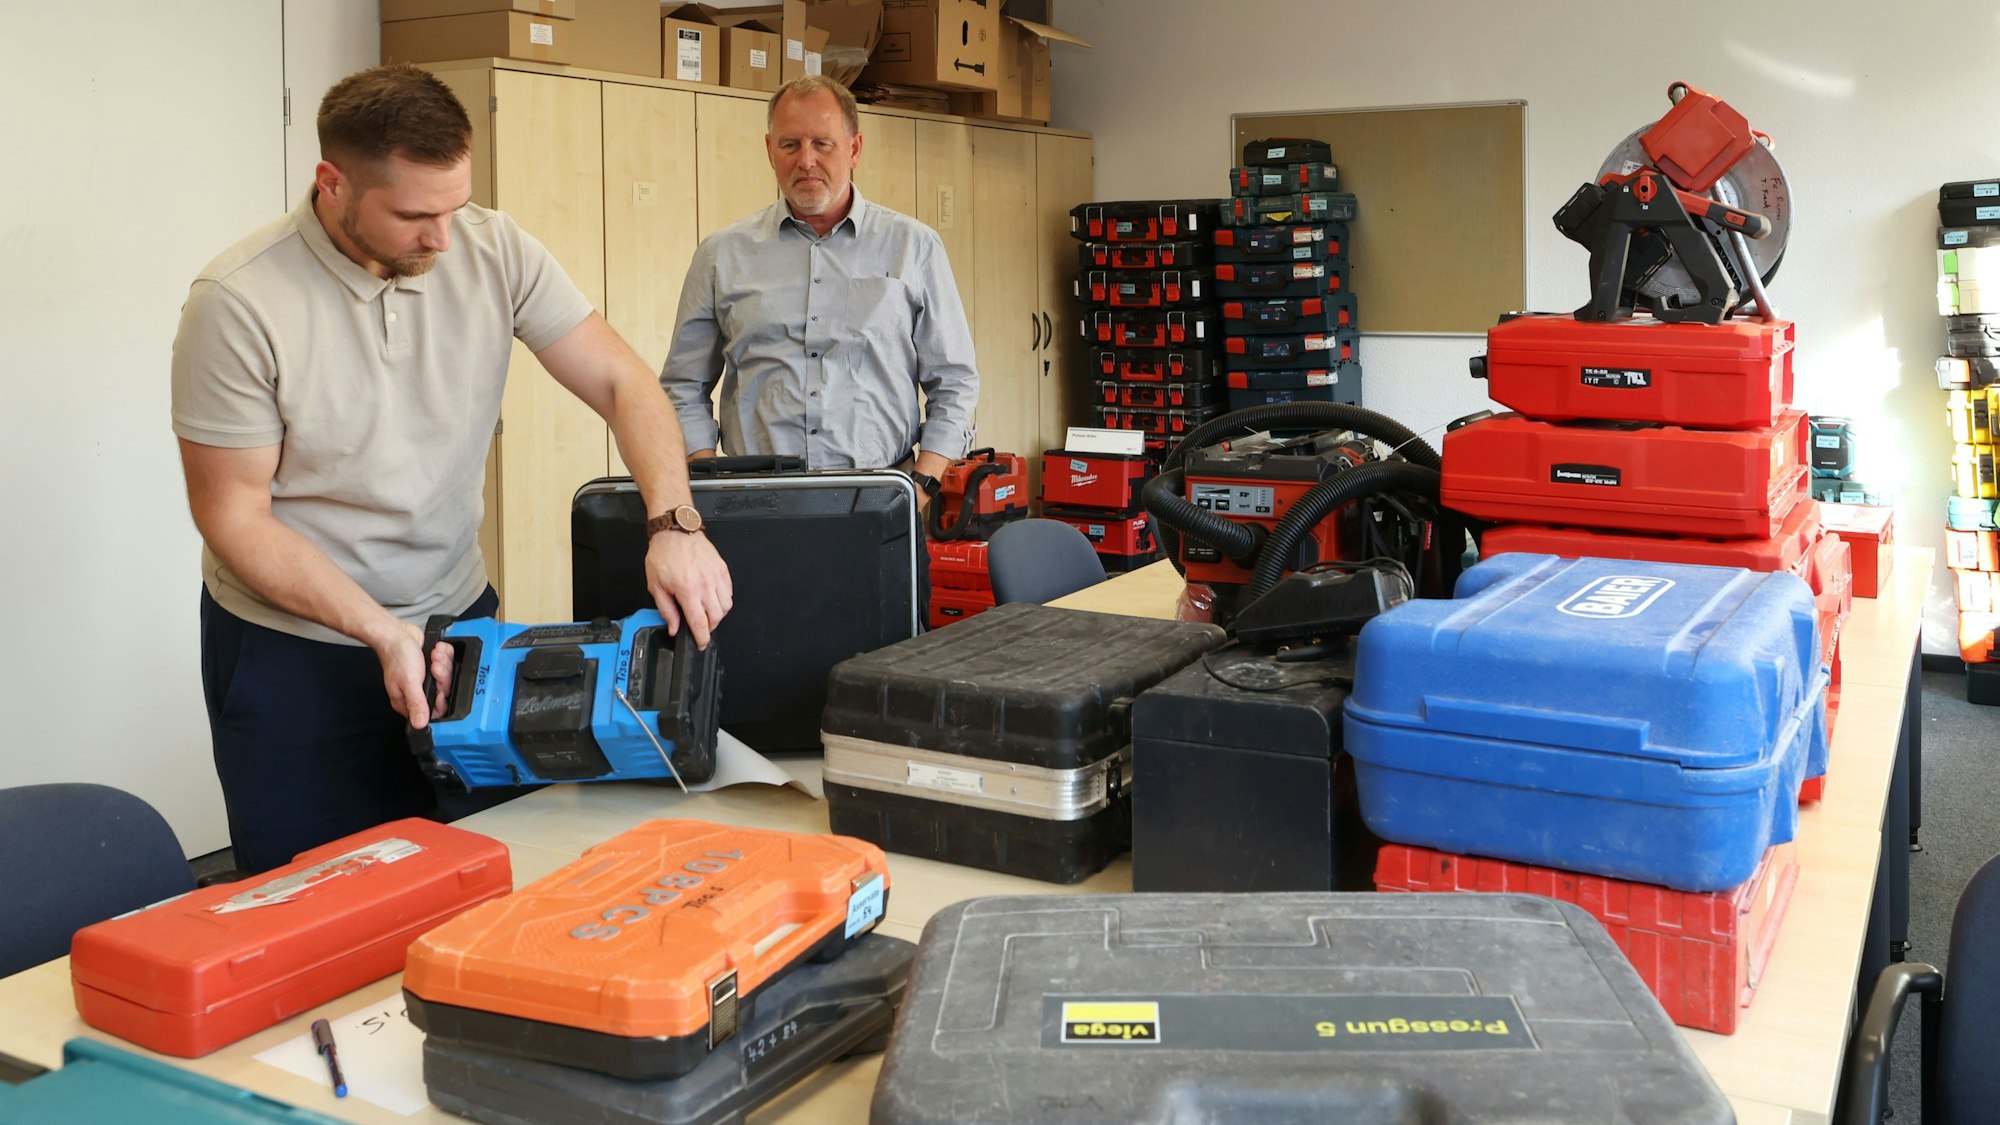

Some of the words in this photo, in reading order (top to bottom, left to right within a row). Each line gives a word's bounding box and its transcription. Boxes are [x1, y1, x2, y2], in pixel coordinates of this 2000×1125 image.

[1570, 578, 1662, 615] BAIER
[571, 848, 744, 941] 108PCS
[1072, 1022, 1150, 1040] viega
[1315, 1020, 1336, 1038] 5
[1346, 1018, 1510, 1036] Pressgun
